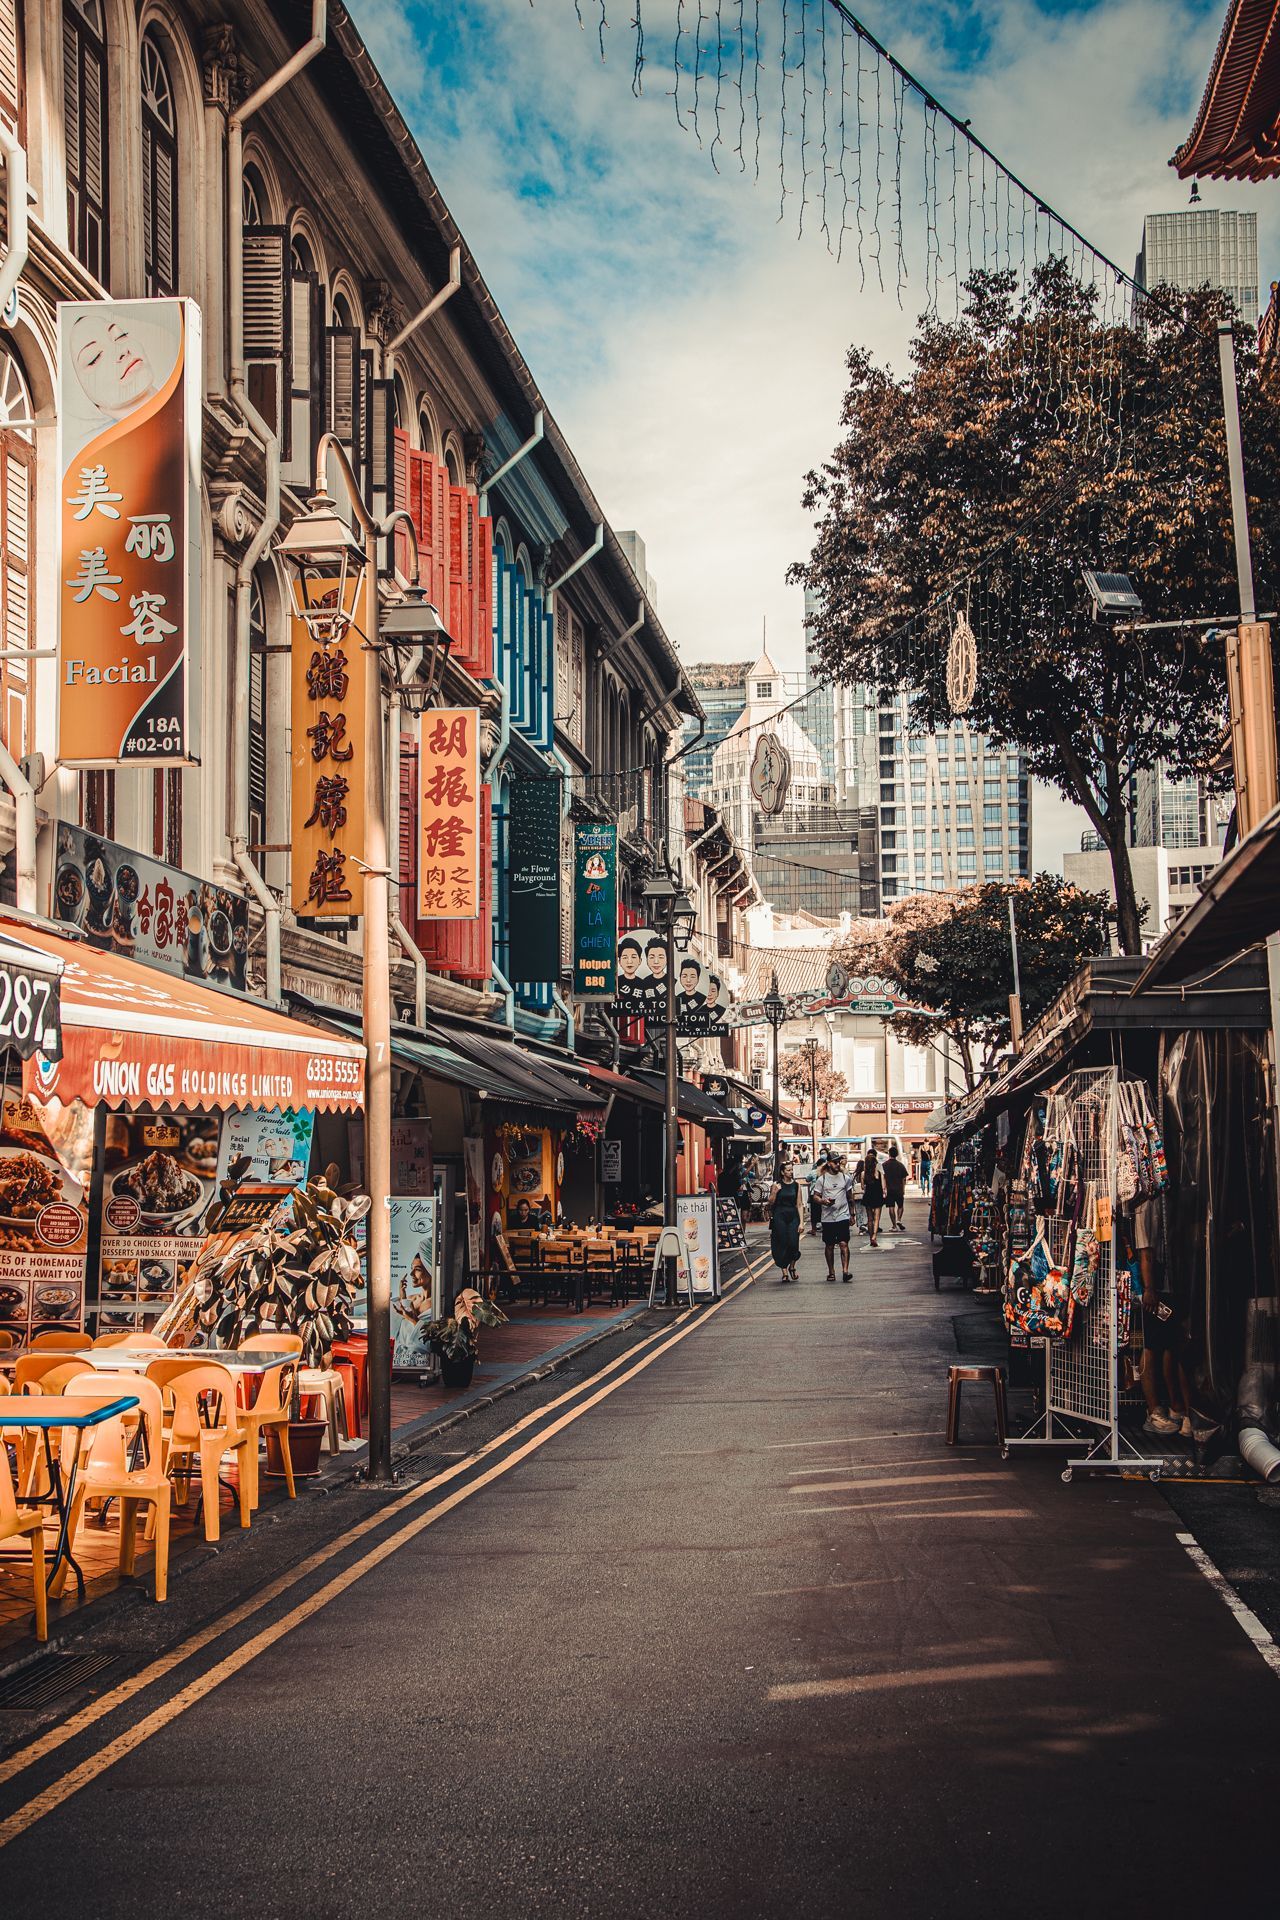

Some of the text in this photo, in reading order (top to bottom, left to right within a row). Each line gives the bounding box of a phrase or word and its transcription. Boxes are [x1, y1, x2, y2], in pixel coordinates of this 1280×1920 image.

[64, 656, 157, 685] Facial
[146, 717, 181, 733] 18A
[126, 737, 182, 752] #02-01
[424, 716, 474, 859] 胡振隆
[531, 865, 550, 873] Flow
[513, 873, 557, 883] Playground
[580, 959, 611, 970] Hotpot
[585, 976, 605, 987] BBQ
[611, 1001, 631, 1009] NIC
[375, 1042, 384, 1062] 7
[307, 1058, 359, 1083] 6333 5555
[93, 1061, 140, 1095] UNION
[147, 1063, 175, 1095] GAS
[181, 1069, 247, 1096] HOLDINGS
[252, 1075, 292, 1097] LIMITED
[671, 1106, 676, 1116] 9
[891, 1102, 909, 1112] Kaya
[910, 1101, 934, 1109] Toast
[256, 1115, 285, 1126] Beauty
[270, 1127, 290, 1135] Nails
[231, 1135, 249, 1143] Facial
[603, 1142, 620, 1153] VR
[252, 1158, 269, 1166] dling
[407, 1201, 431, 1218] Spa
[677, 1202, 708, 1213] hè thái
[14, 1256, 26, 1265] OF
[30, 1257, 83, 1268] HOMEMADE
[34, 1269, 62, 1279] AWAIT
[65, 1271, 82, 1279] YOU
